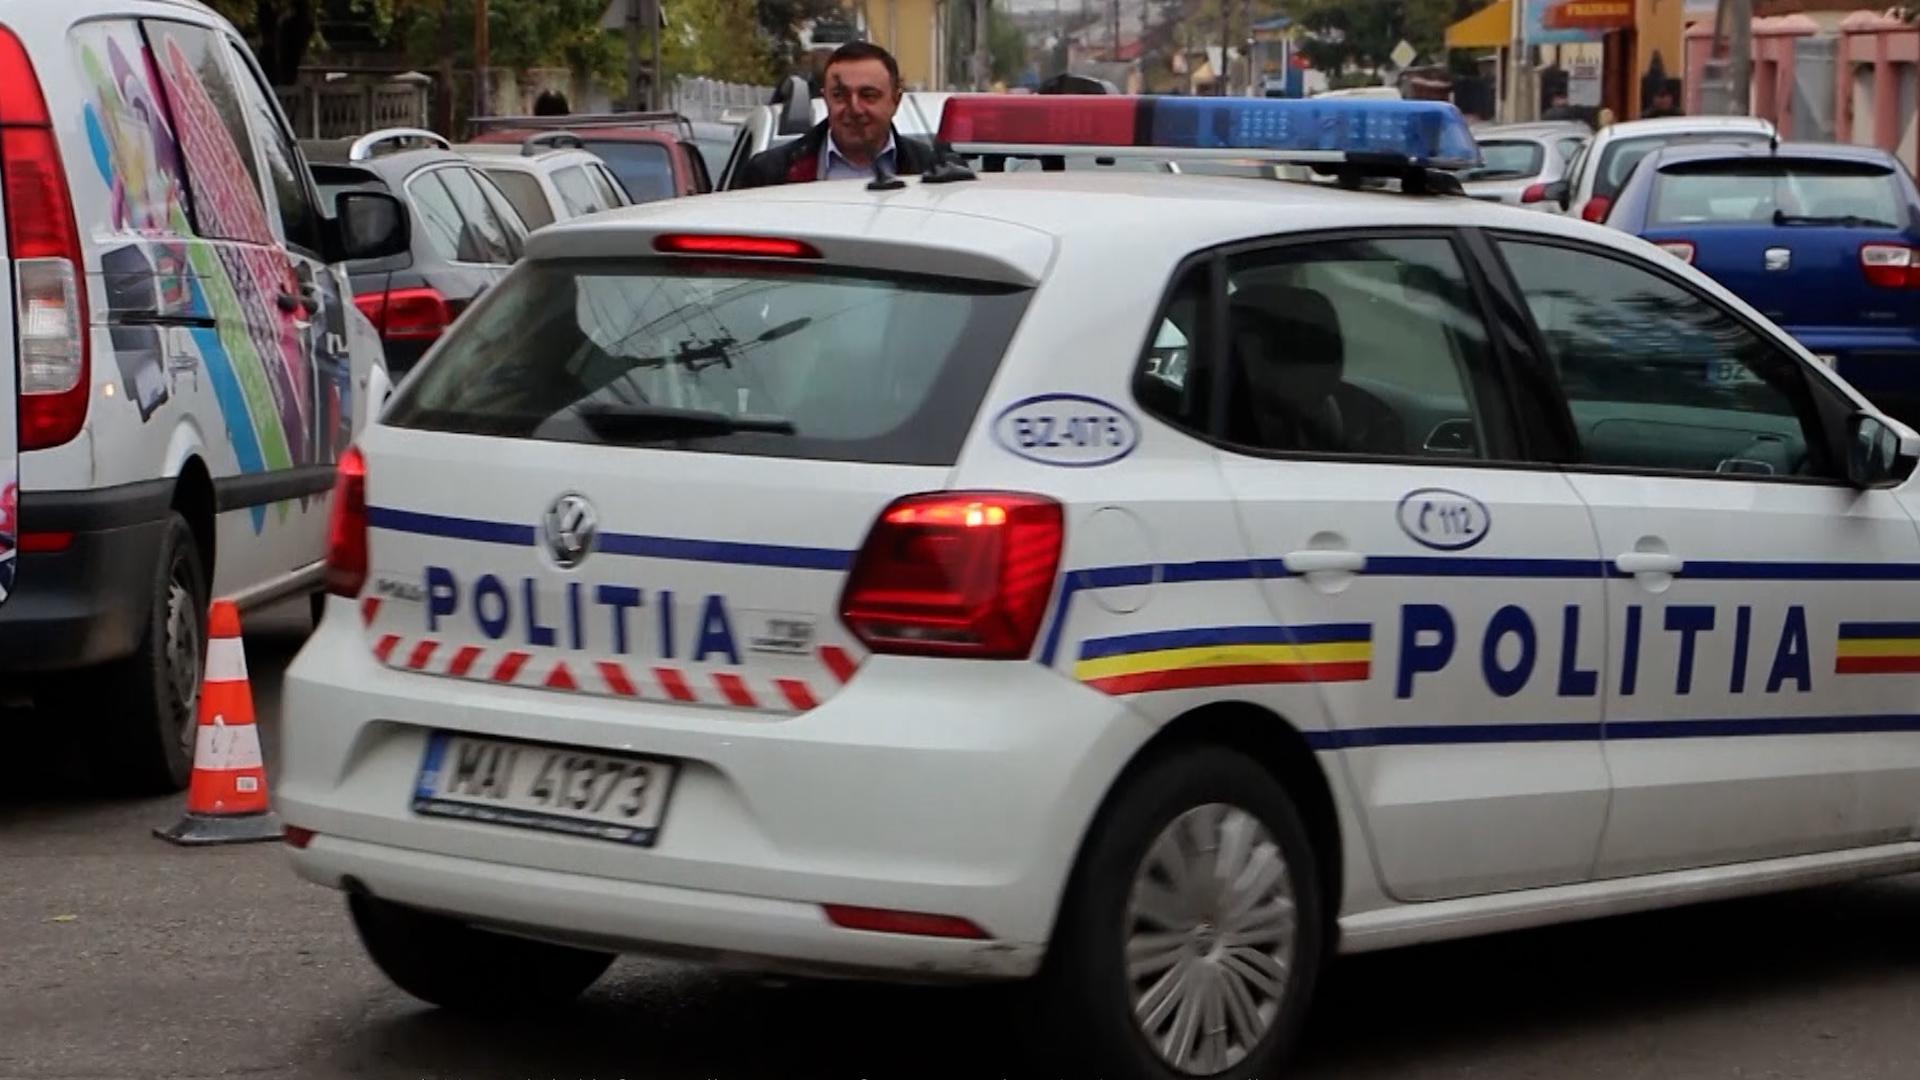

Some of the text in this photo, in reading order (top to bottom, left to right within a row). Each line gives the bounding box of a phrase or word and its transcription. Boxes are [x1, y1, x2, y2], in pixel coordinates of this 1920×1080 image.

[1440, 506, 1474, 534] 112
[424, 565, 743, 665] POLITIA
[1395, 603, 1813, 699] POLITIA
[447, 741, 652, 819] MAI 41373
